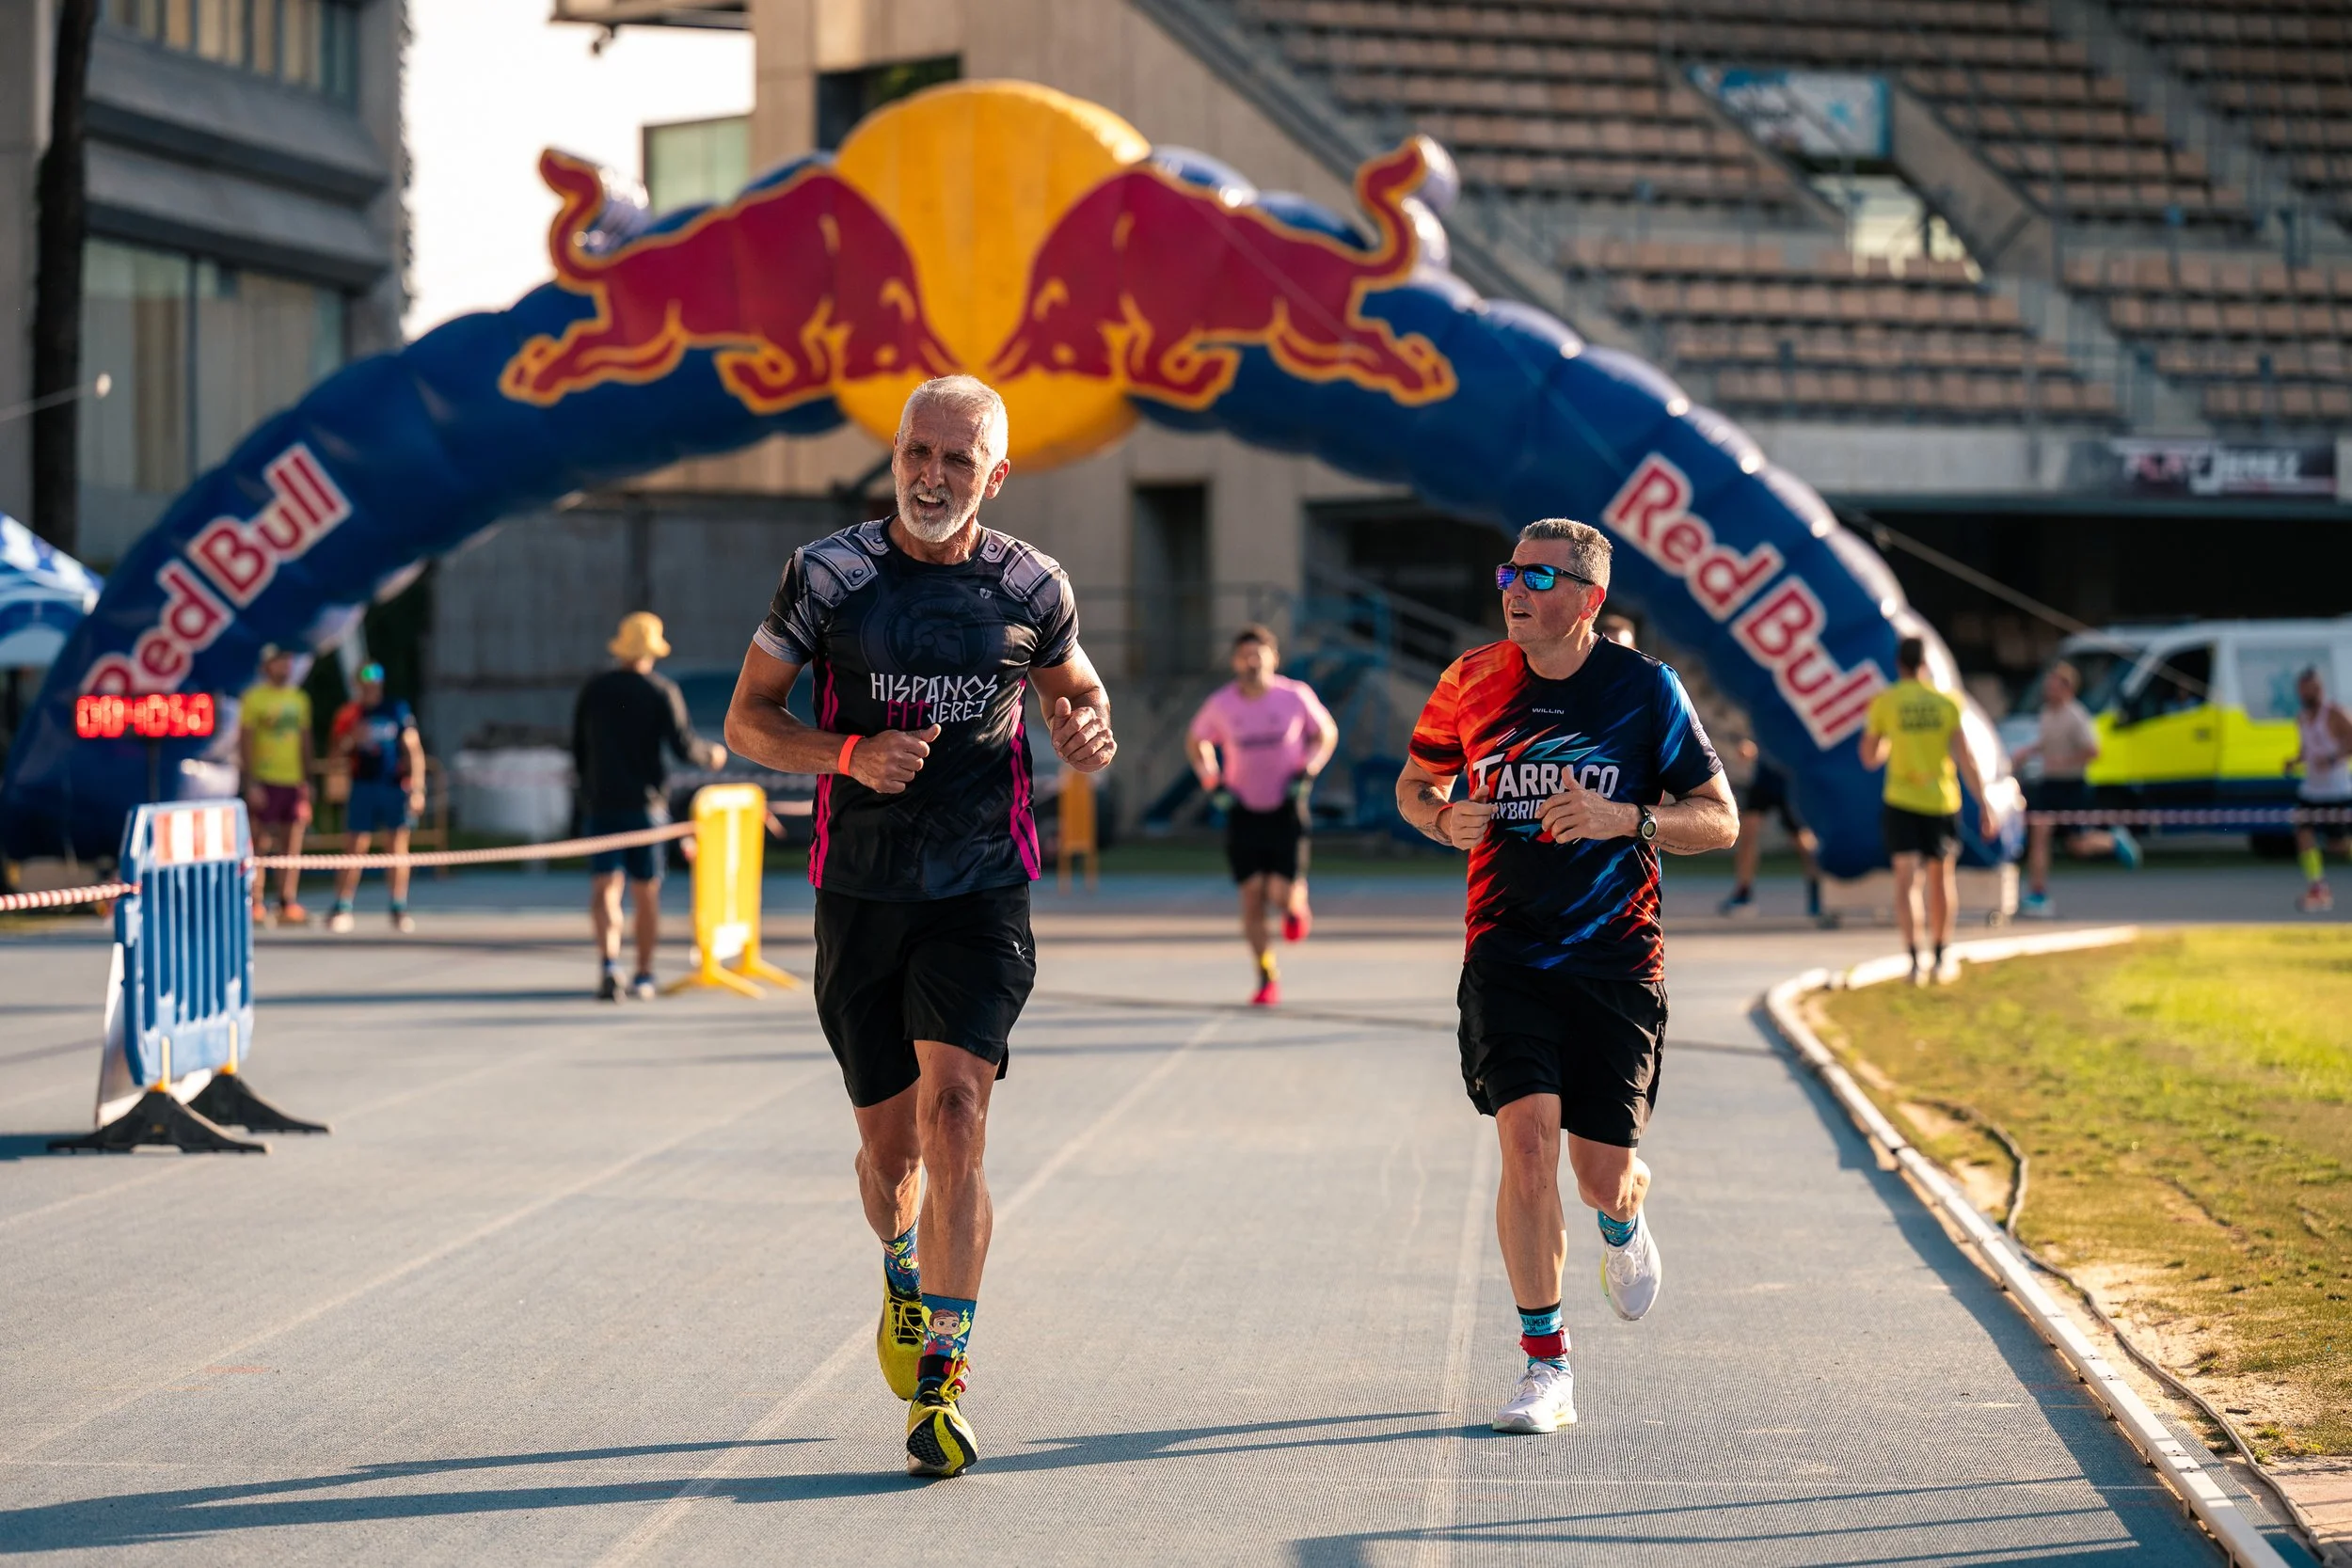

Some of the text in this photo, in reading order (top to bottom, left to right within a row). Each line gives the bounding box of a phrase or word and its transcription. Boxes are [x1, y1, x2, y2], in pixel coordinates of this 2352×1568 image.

[187, 443, 352, 608] Bull
[1602, 453, 1888, 750] Red Bull
[869, 672, 999, 705] HISPANOS
[886, 698, 988, 730] FIT JEREZ
